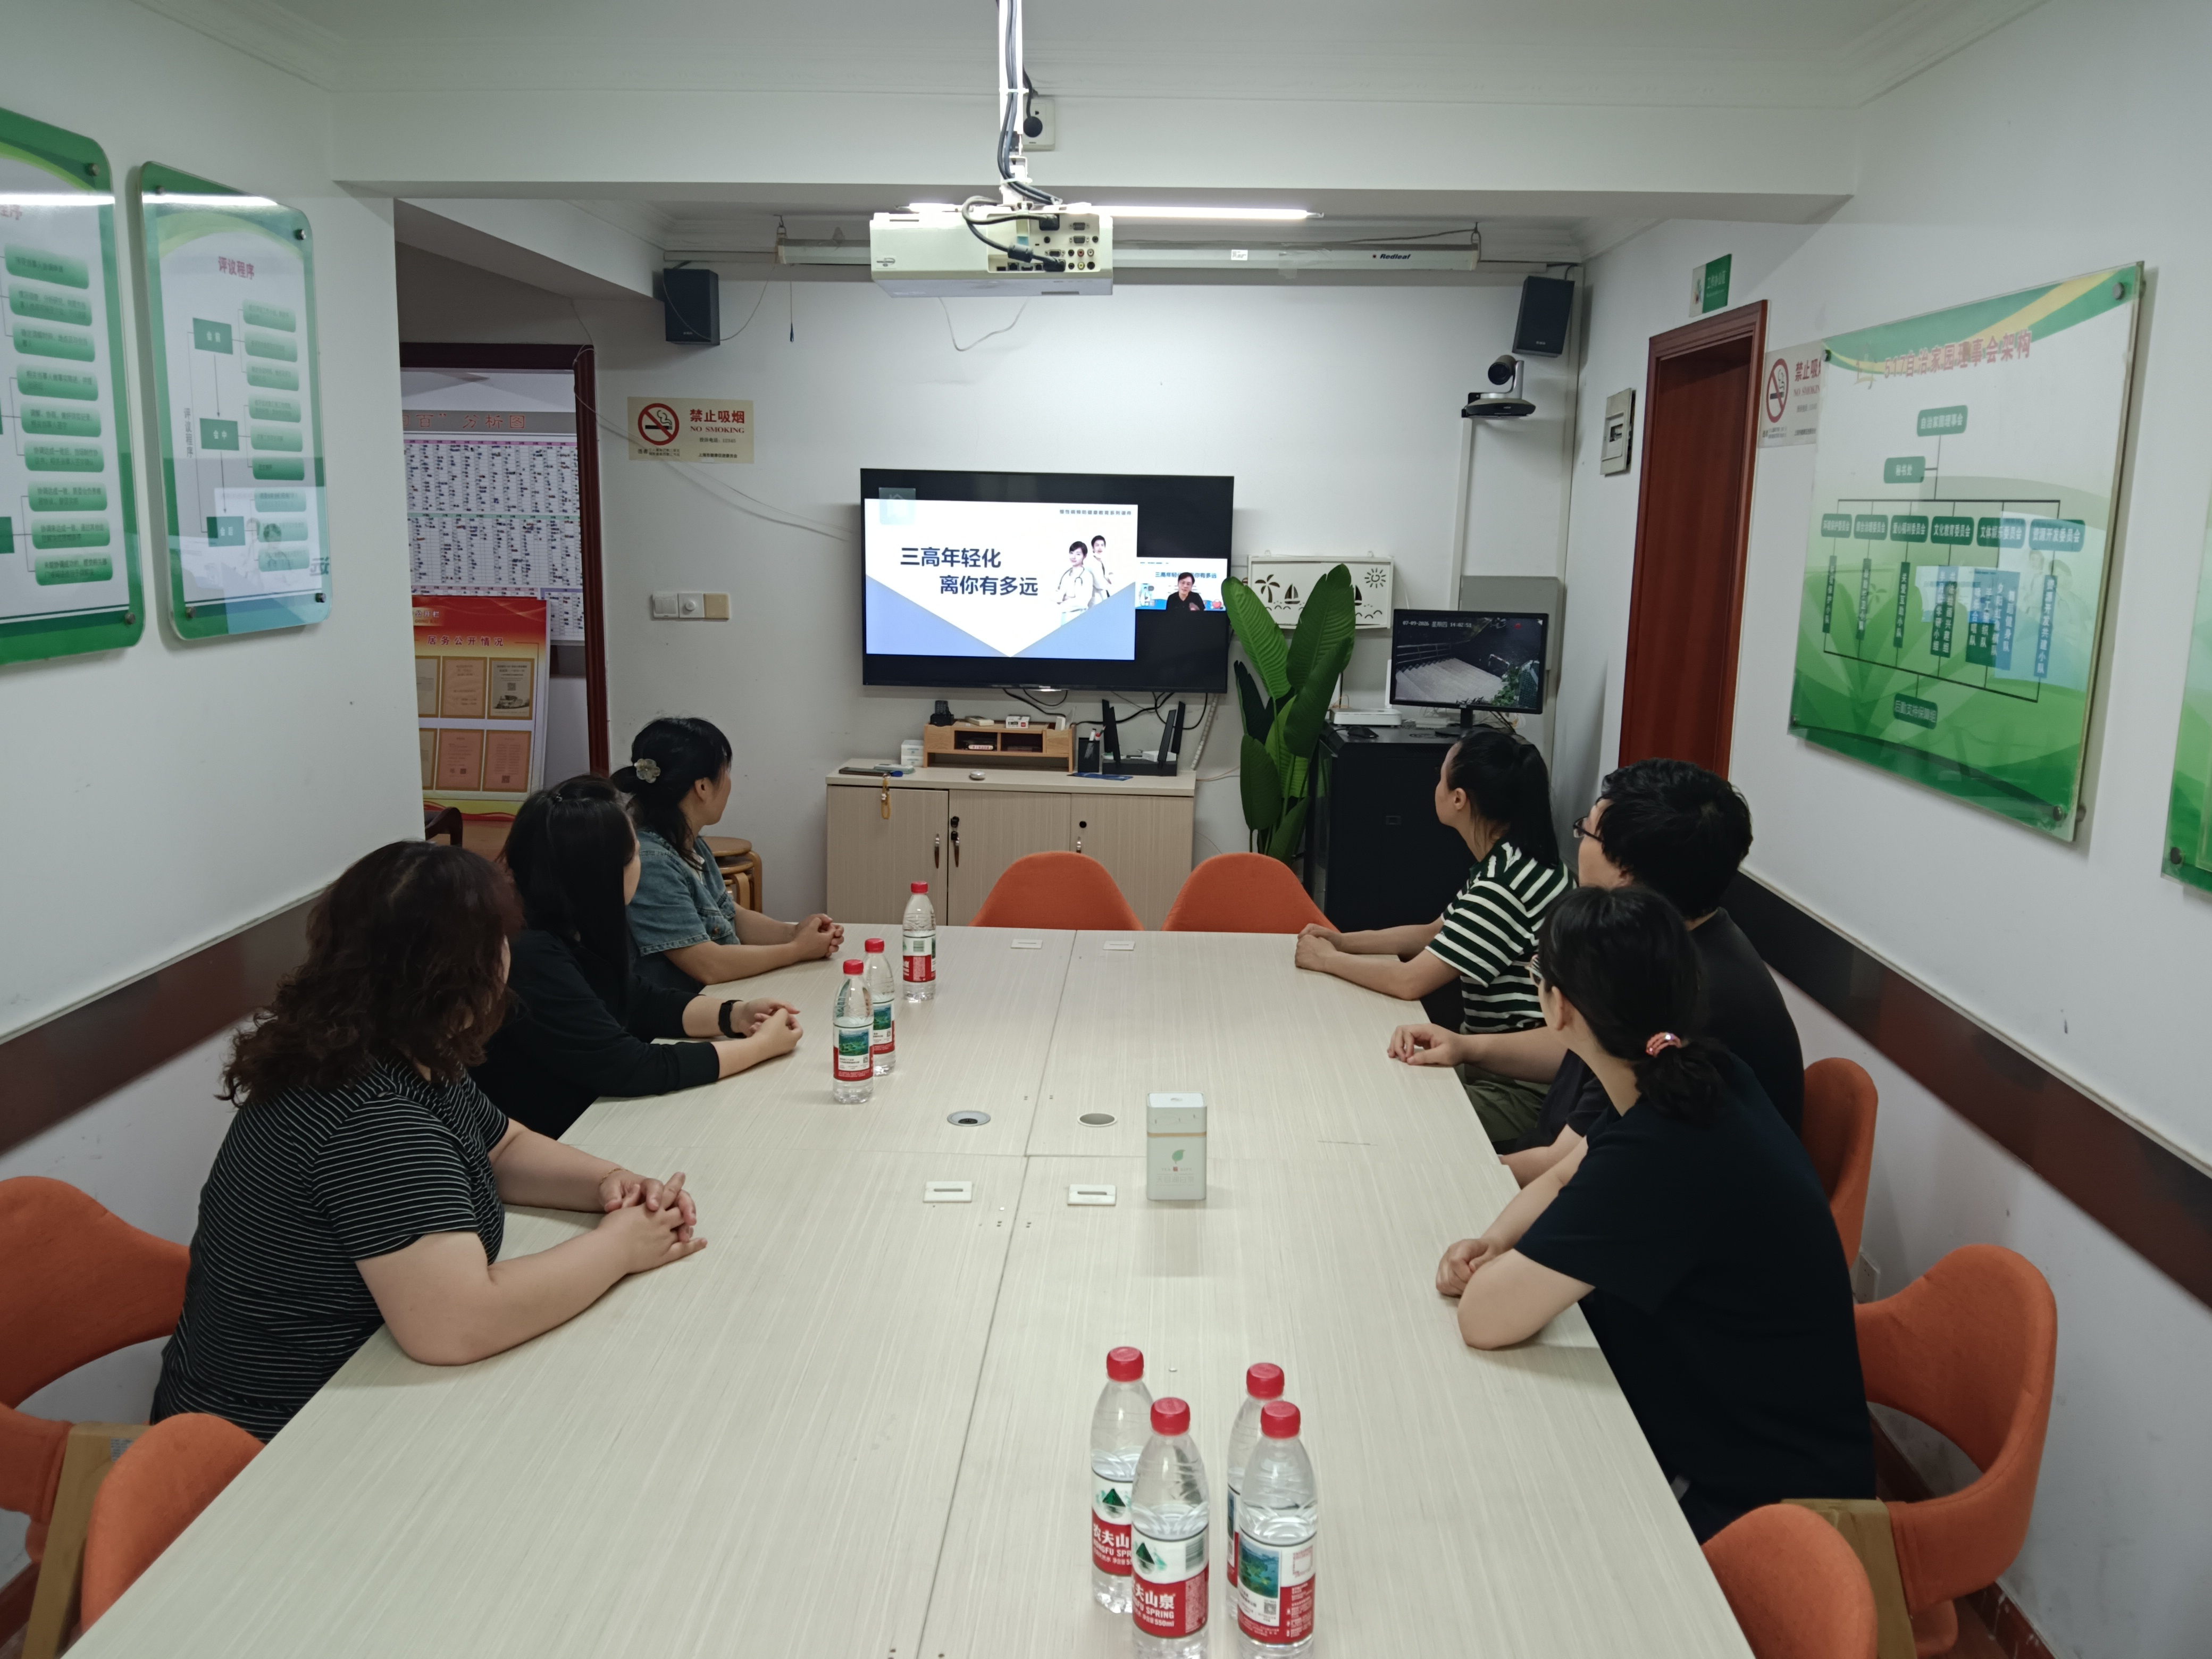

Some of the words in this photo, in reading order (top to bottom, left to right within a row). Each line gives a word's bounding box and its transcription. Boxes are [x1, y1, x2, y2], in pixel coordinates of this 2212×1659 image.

[219, 256, 254, 280] 评议程序
[1885, 330, 2032, 378] 517自治家园理事会架构
[463, 414, 525, 429] 分析图
[690, 409, 744, 423] 禁止吸烟
[1921, 413, 1963, 429] 自治家园理事会
[184, 408, 193, 458] 评议程序
[1896, 464, 1912, 476] 秘书处
[1933, 523, 1971, 538] 文化教育委员会
[1980, 524, 2022, 540] 文体娱乐委员会
[2032, 526, 2081, 543] 资源开发委员会
[901, 547, 1001, 568] 三高年轻化
[940, 575, 1038, 596] 离你有多远
[1896, 573, 1907, 638] 关爱互助小队
[2037, 579, 2055, 674] 资源开发共建小队
[428, 635, 503, 647] 居务公开情况
[1093, 1524, 1129, 1549] 农夫山
[1146, 1606, 1174, 1619] SPRING
